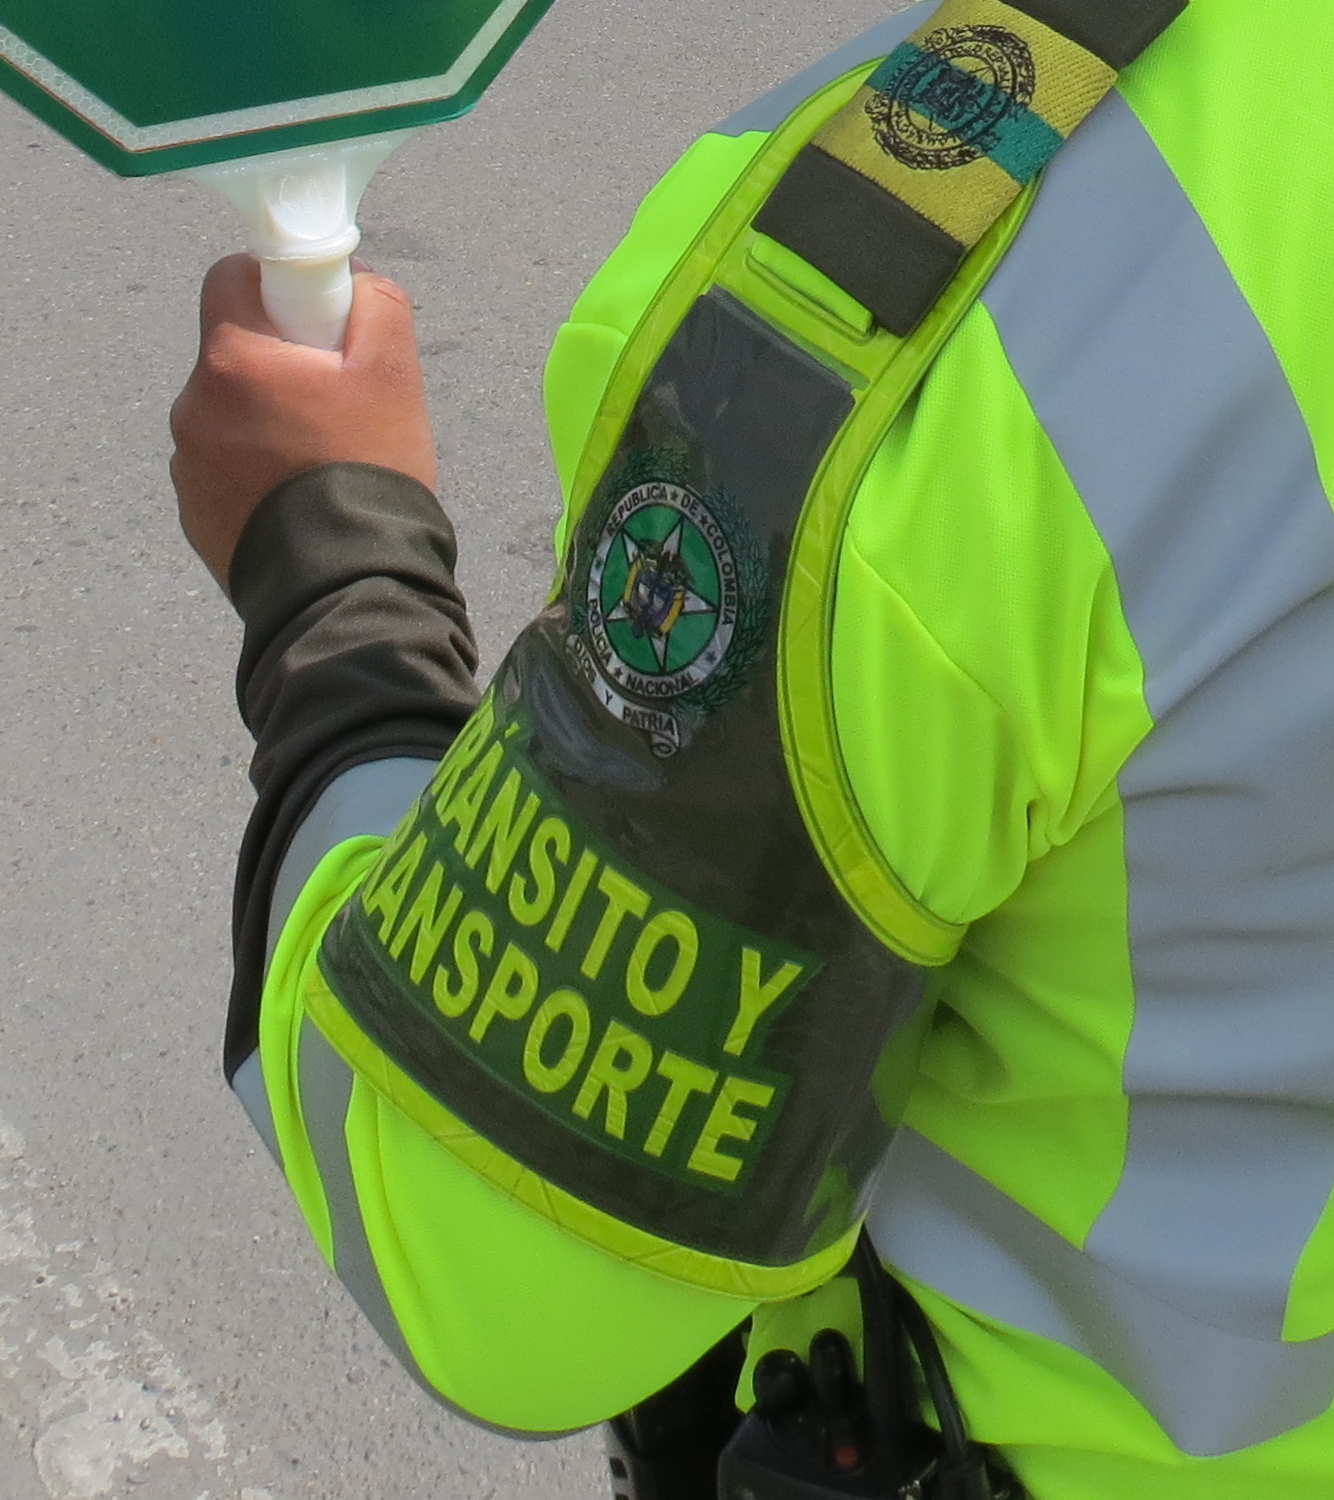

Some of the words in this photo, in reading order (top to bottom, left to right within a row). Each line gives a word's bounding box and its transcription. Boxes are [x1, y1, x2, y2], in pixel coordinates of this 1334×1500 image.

[606, 485, 668, 536] REPUBLICA
[680, 493, 699, 515] DE
[707, 521, 737, 625] COLOMBIA
[589, 599, 612, 667] POLICIA
[626, 672, 699, 695] NACIONAL
[605, 689, 614, 706] Y
[623, 705, 676, 737] PATRIA
[430, 682, 700, 1016] RÁNSITO
[723, 945, 804, 1056] Y
